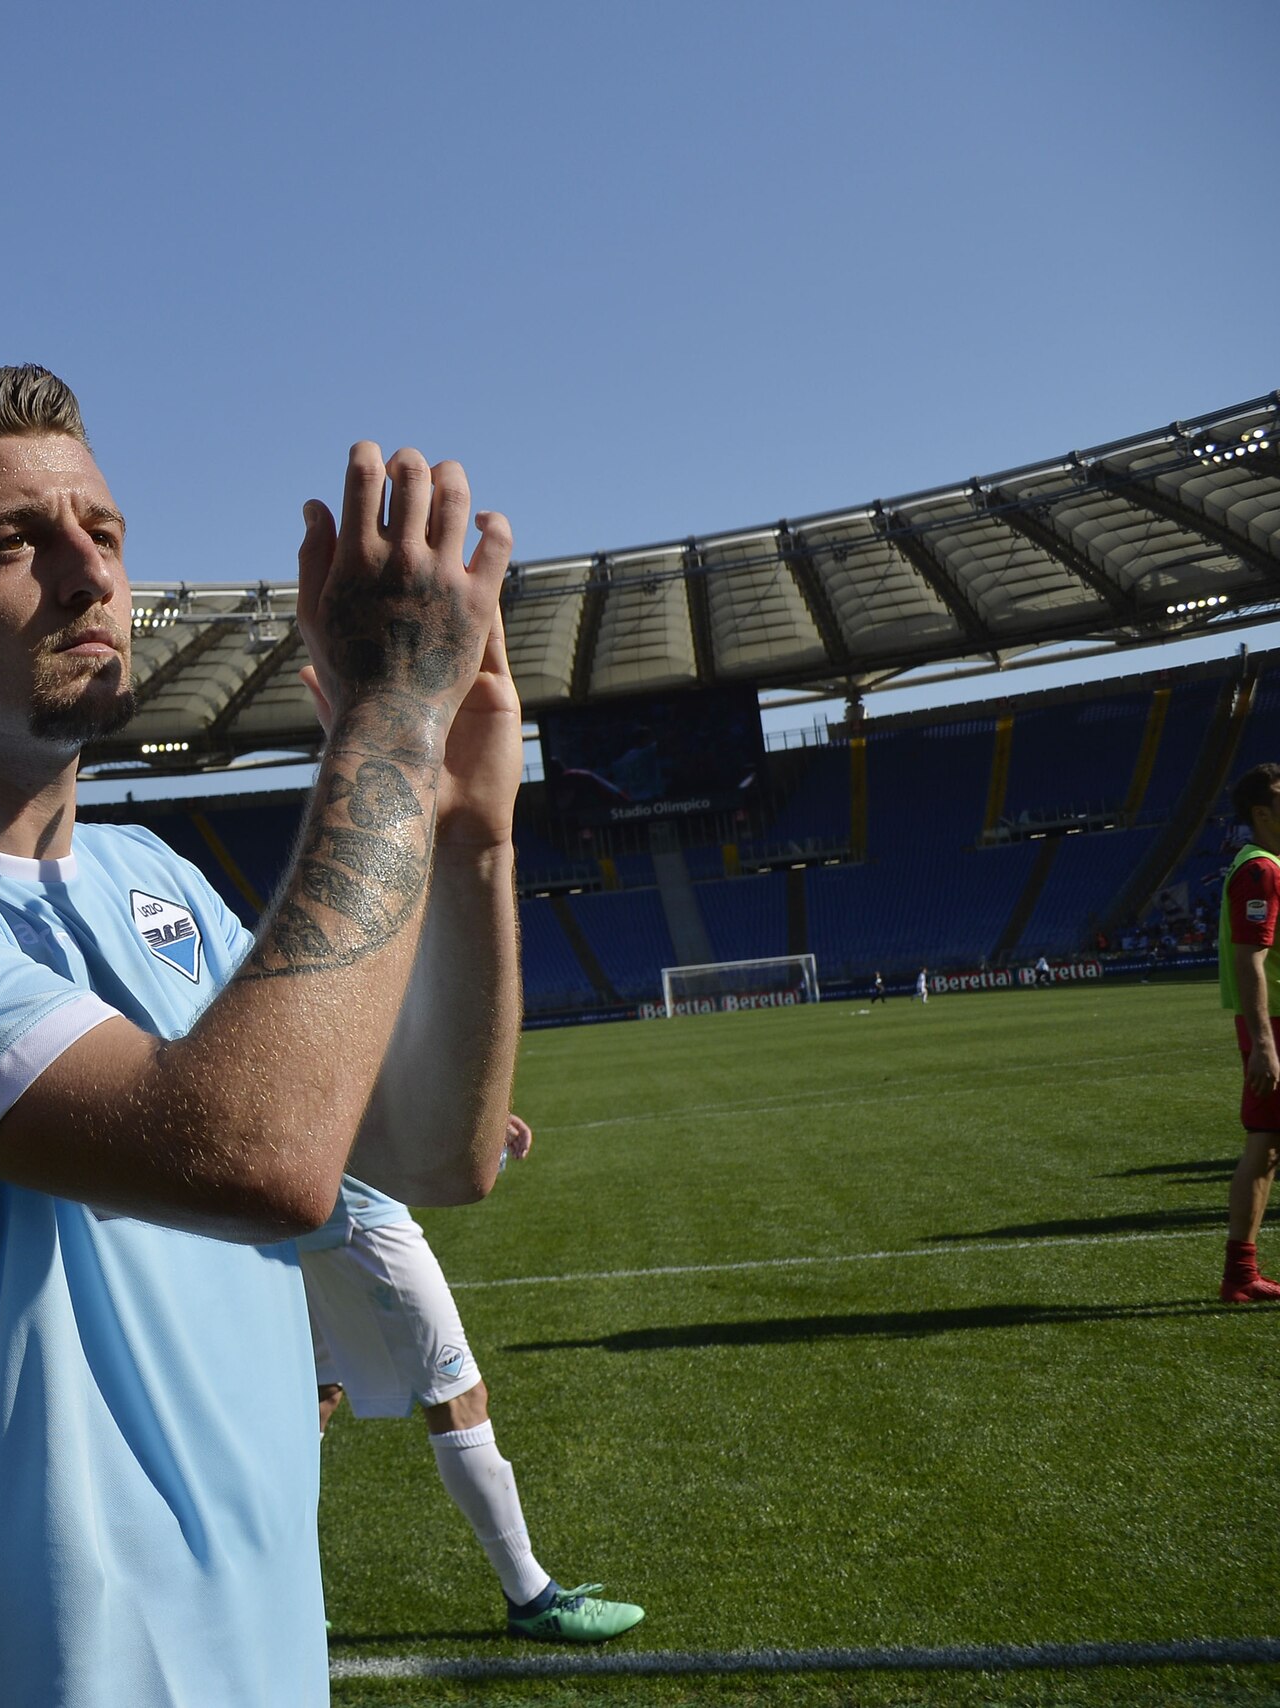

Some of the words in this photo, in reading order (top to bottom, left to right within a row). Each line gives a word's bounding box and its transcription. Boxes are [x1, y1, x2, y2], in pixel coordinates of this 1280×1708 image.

[610, 804, 652, 820] Stadio
[653, 797, 711, 814] Olimpico
[137, 902, 163, 918] LAZIO
[935, 969, 1008, 993] Beretta
[1023, 963, 1098, 985] Bretta
[726, 990, 796, 1012] Beretta
